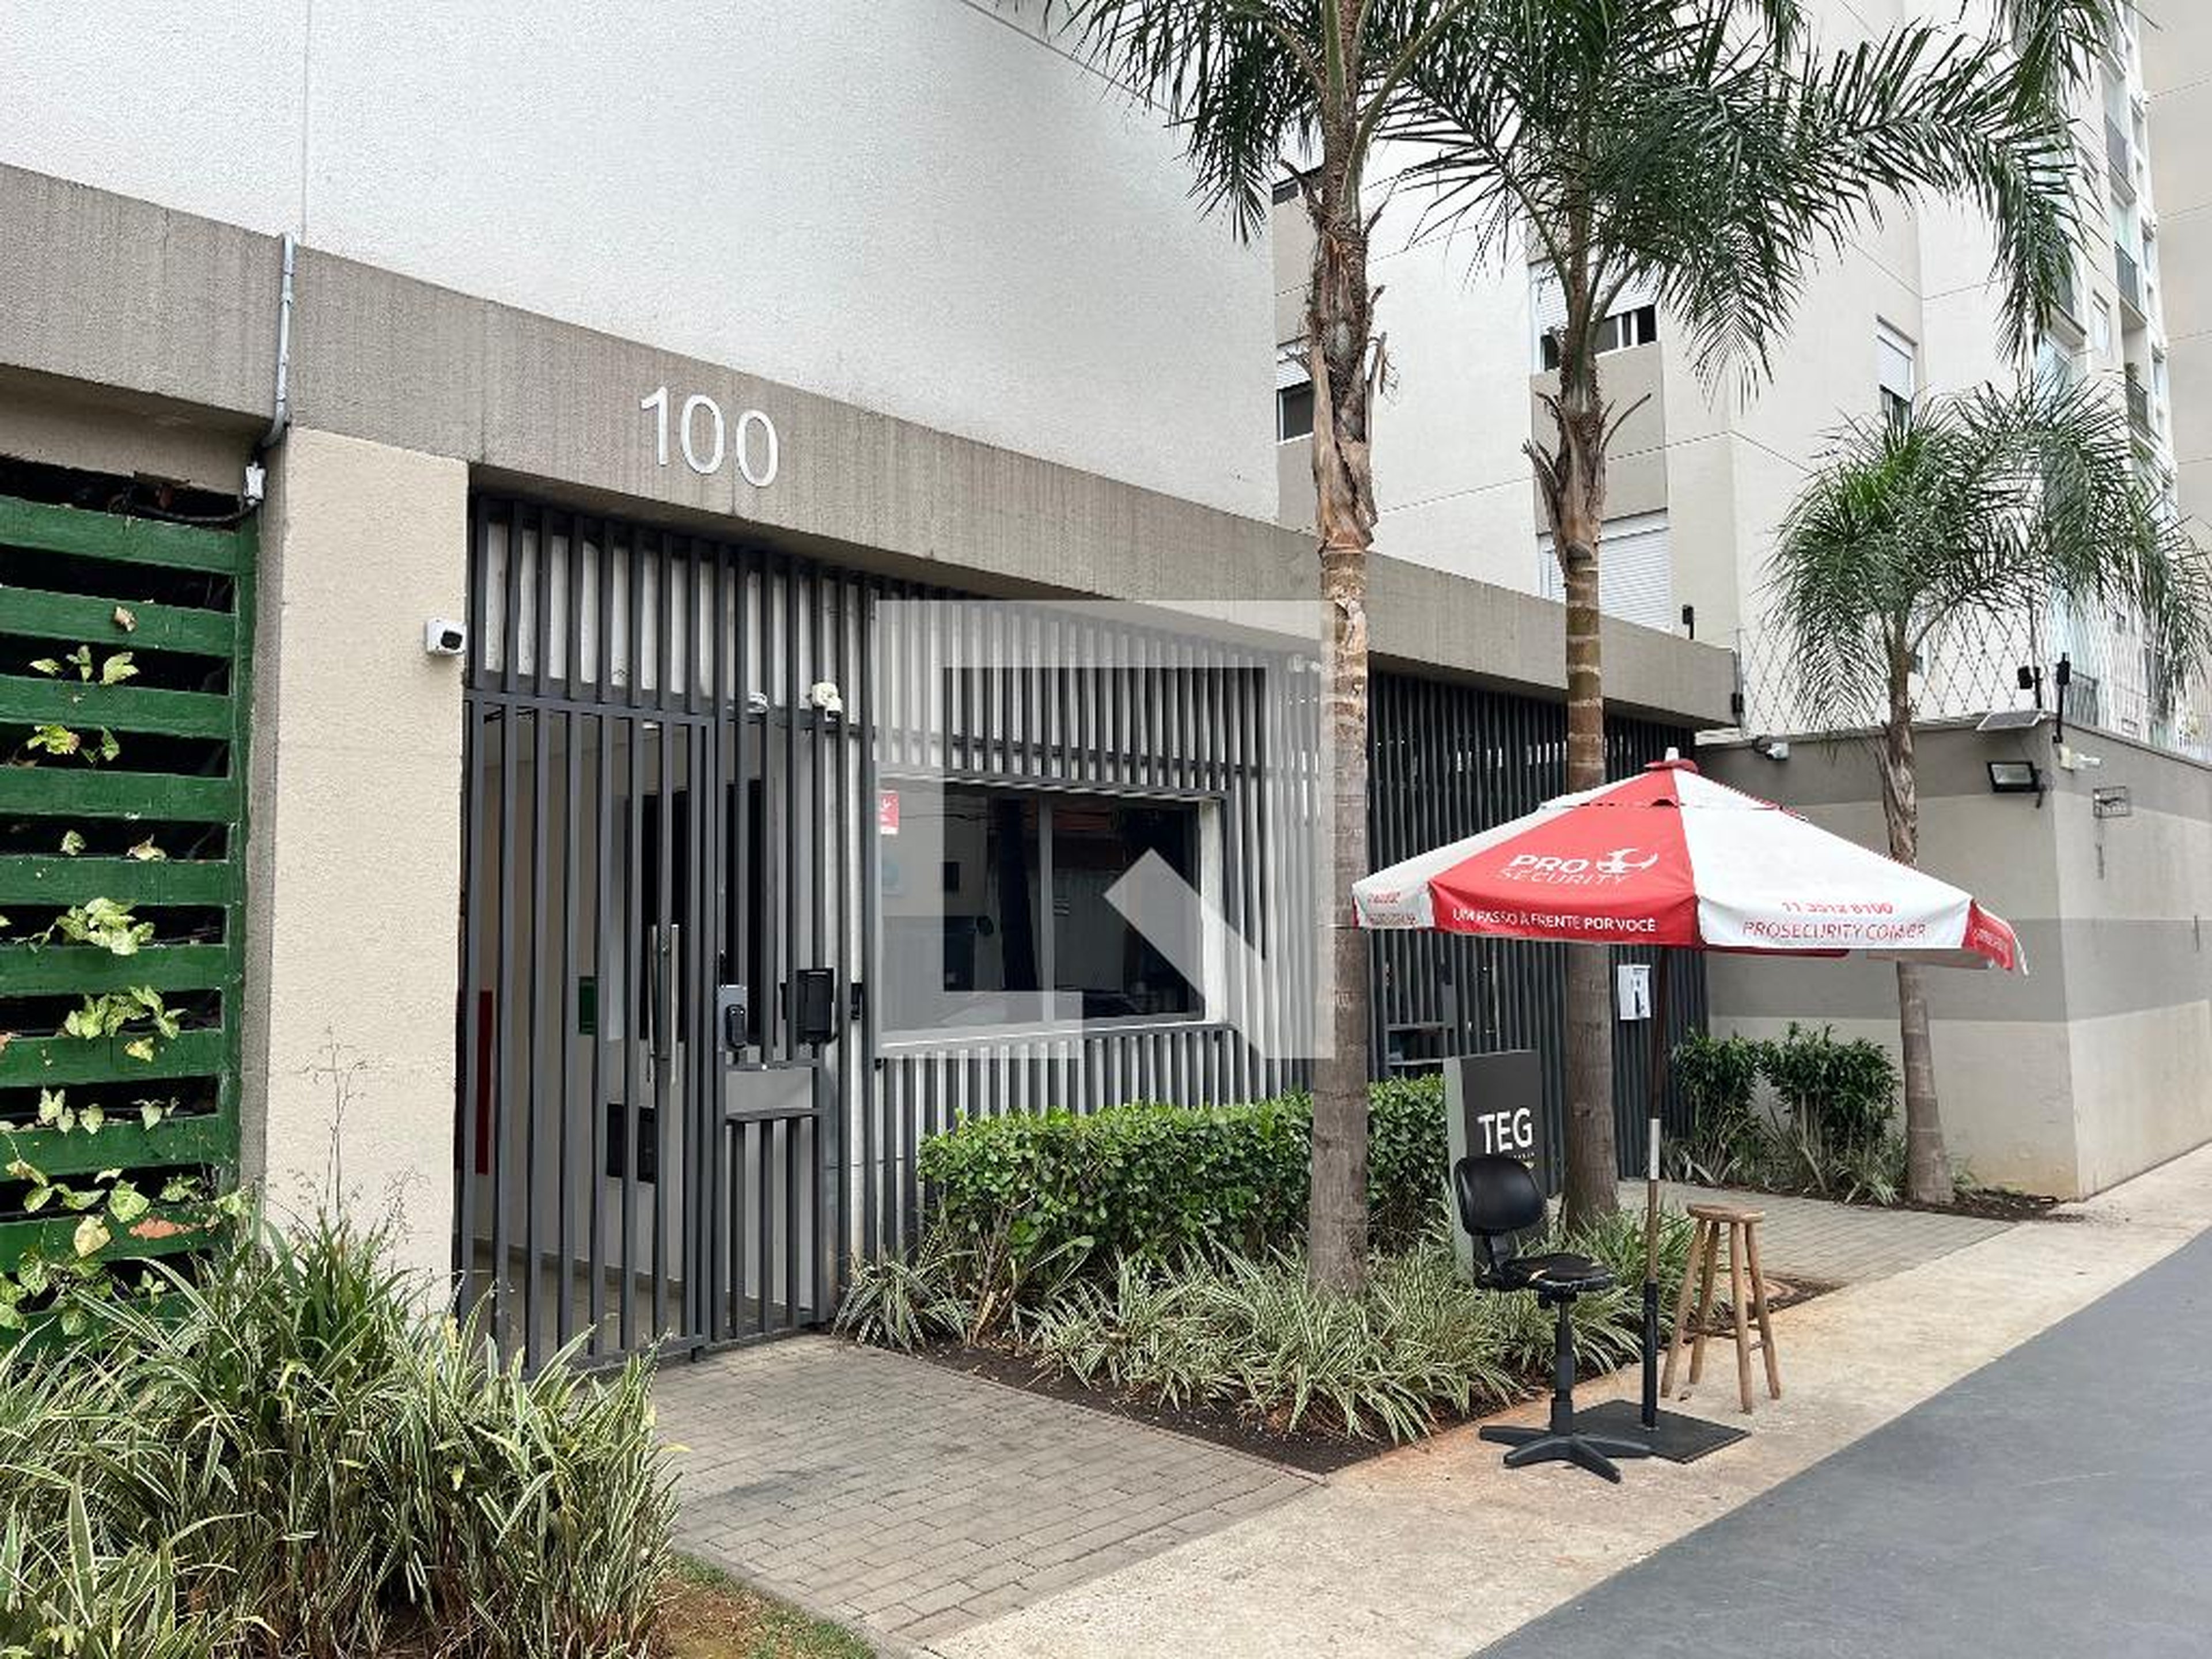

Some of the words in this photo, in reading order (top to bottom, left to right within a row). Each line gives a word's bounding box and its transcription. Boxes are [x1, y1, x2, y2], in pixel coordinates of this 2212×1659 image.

[640, 386, 778, 488] 100
[1510, 854, 1590, 873] PRO
[1501, 868, 1631, 885] SECURITY
[1476, 910, 1518, 926] PASSO
[1530, 913, 1581, 930] FRENTE
[1584, 917, 1615, 930] POR
[1615, 917, 1657, 933] VOCÊ
[1477, 1108, 1533, 1154] TEG
